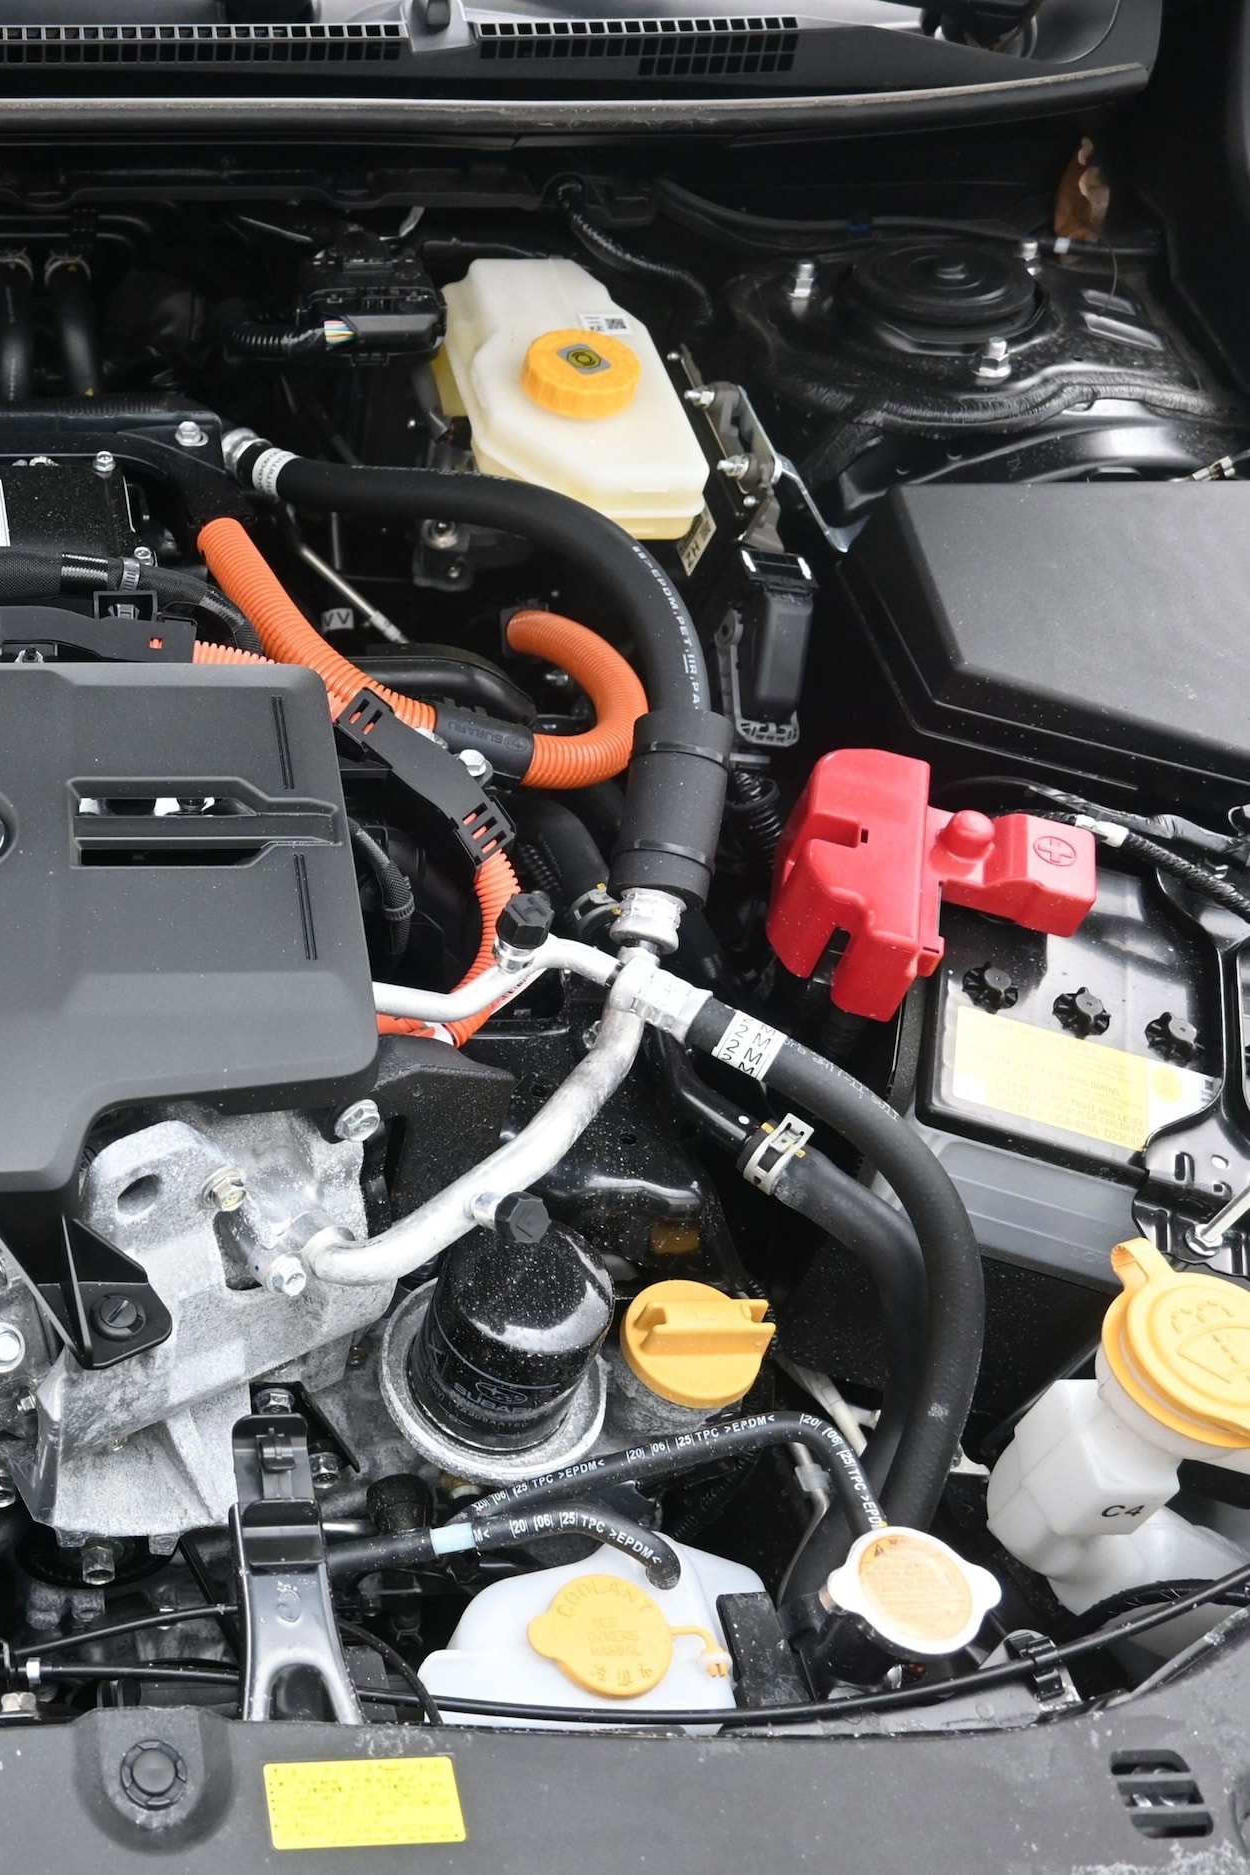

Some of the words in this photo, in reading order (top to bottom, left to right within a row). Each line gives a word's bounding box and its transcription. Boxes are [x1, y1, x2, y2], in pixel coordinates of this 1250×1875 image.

[448, 721, 503, 745] SUBARU
[734, 1023, 749, 1038] 2
[752, 1032, 772, 1050] M
[725, 1039, 740, 1053] 2
[743, 1047, 763, 1066] M
[696, 1427, 720, 1442] TPC
[532, 1475, 554, 1488] TPC
[580, 1514, 606, 1533] TPC
[557, 1579, 653, 1618] COOLANT
